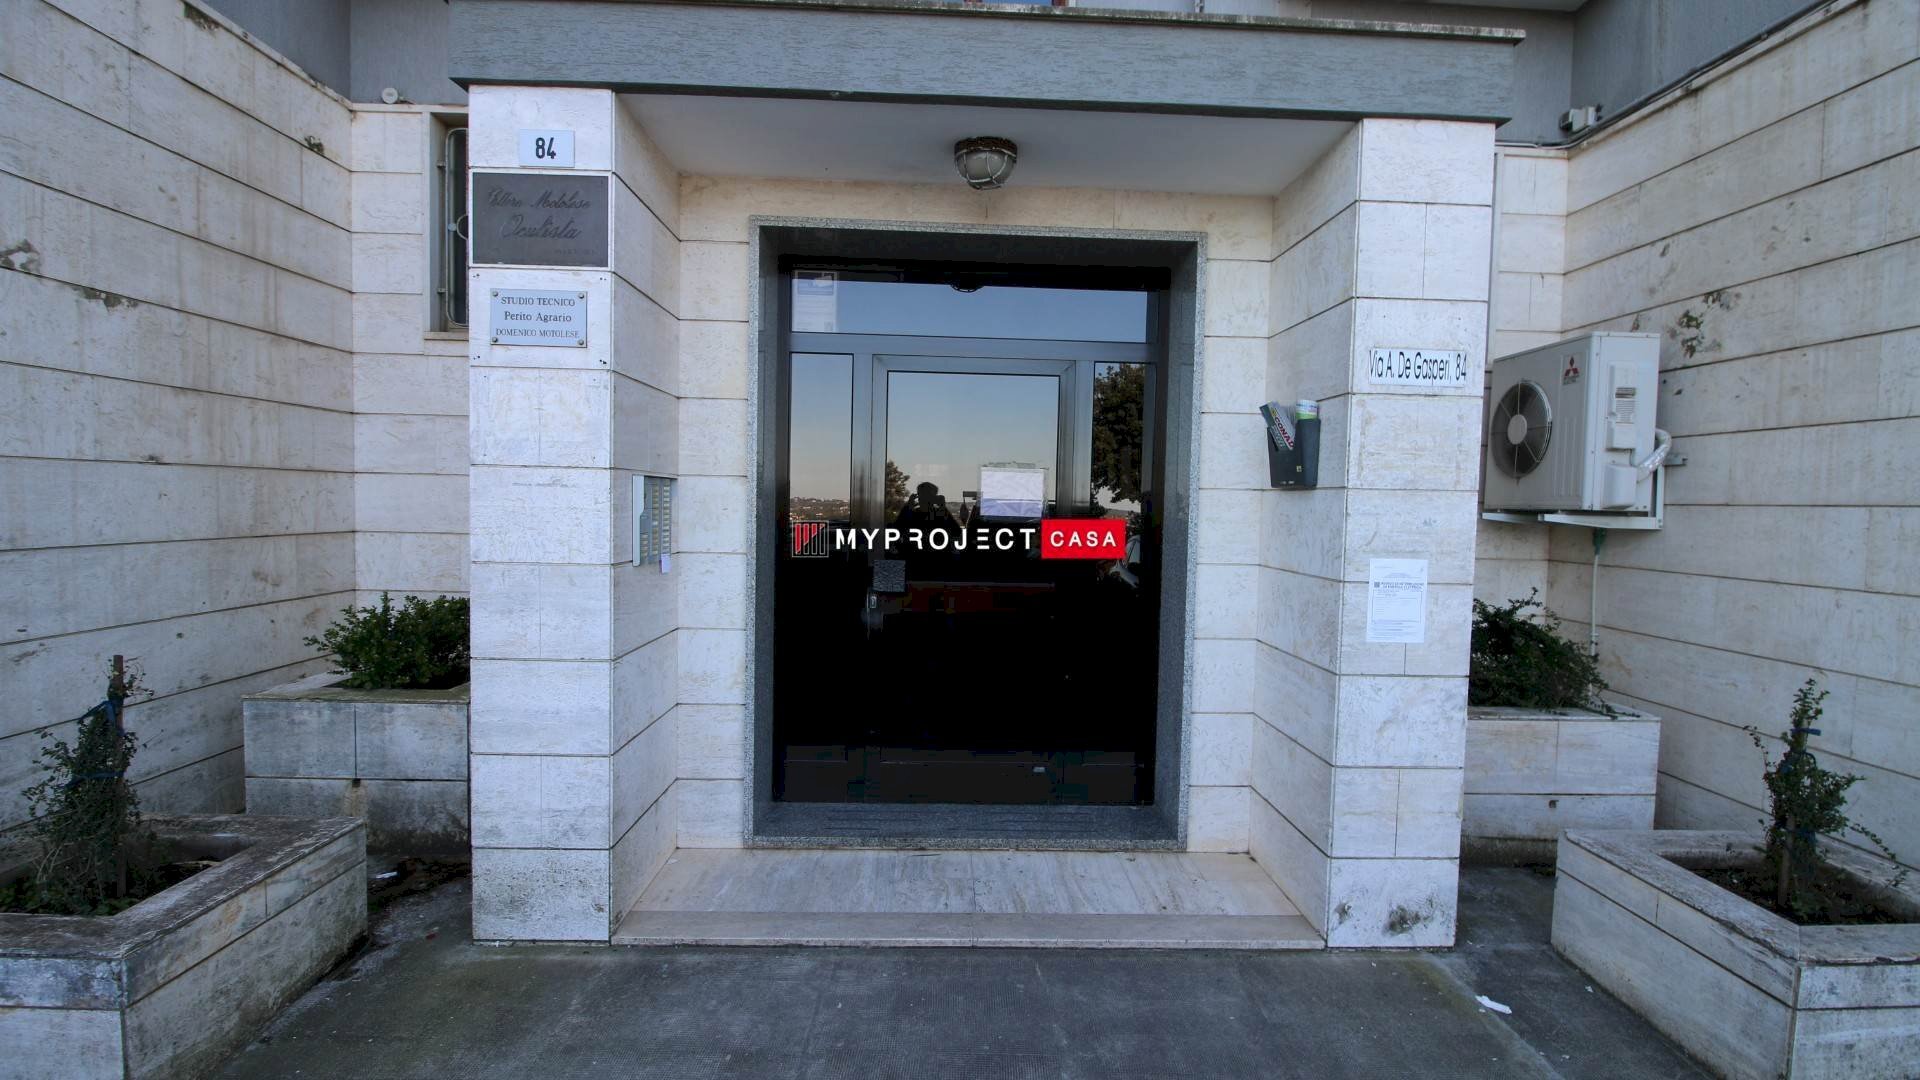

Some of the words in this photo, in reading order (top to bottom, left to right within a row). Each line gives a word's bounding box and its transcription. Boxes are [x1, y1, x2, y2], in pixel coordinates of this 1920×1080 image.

[535, 137, 556, 159] 84
[500, 296, 535, 306] STUDIO
[536, 297, 576, 307] TECNICO
[504, 311, 532, 321] Perito
[535, 313, 572, 323] Agrario
[496, 328, 537, 337] DOMENICO
[539, 330, 580, 339] MOTOLESE
[1369, 350, 1384, 378] Via
[1386, 351, 1395, 379] A.
[1398, 351, 1412, 379] De
[1455, 353, 1467, 381] 84
[1274, 416, 1295, 448] CONAD
